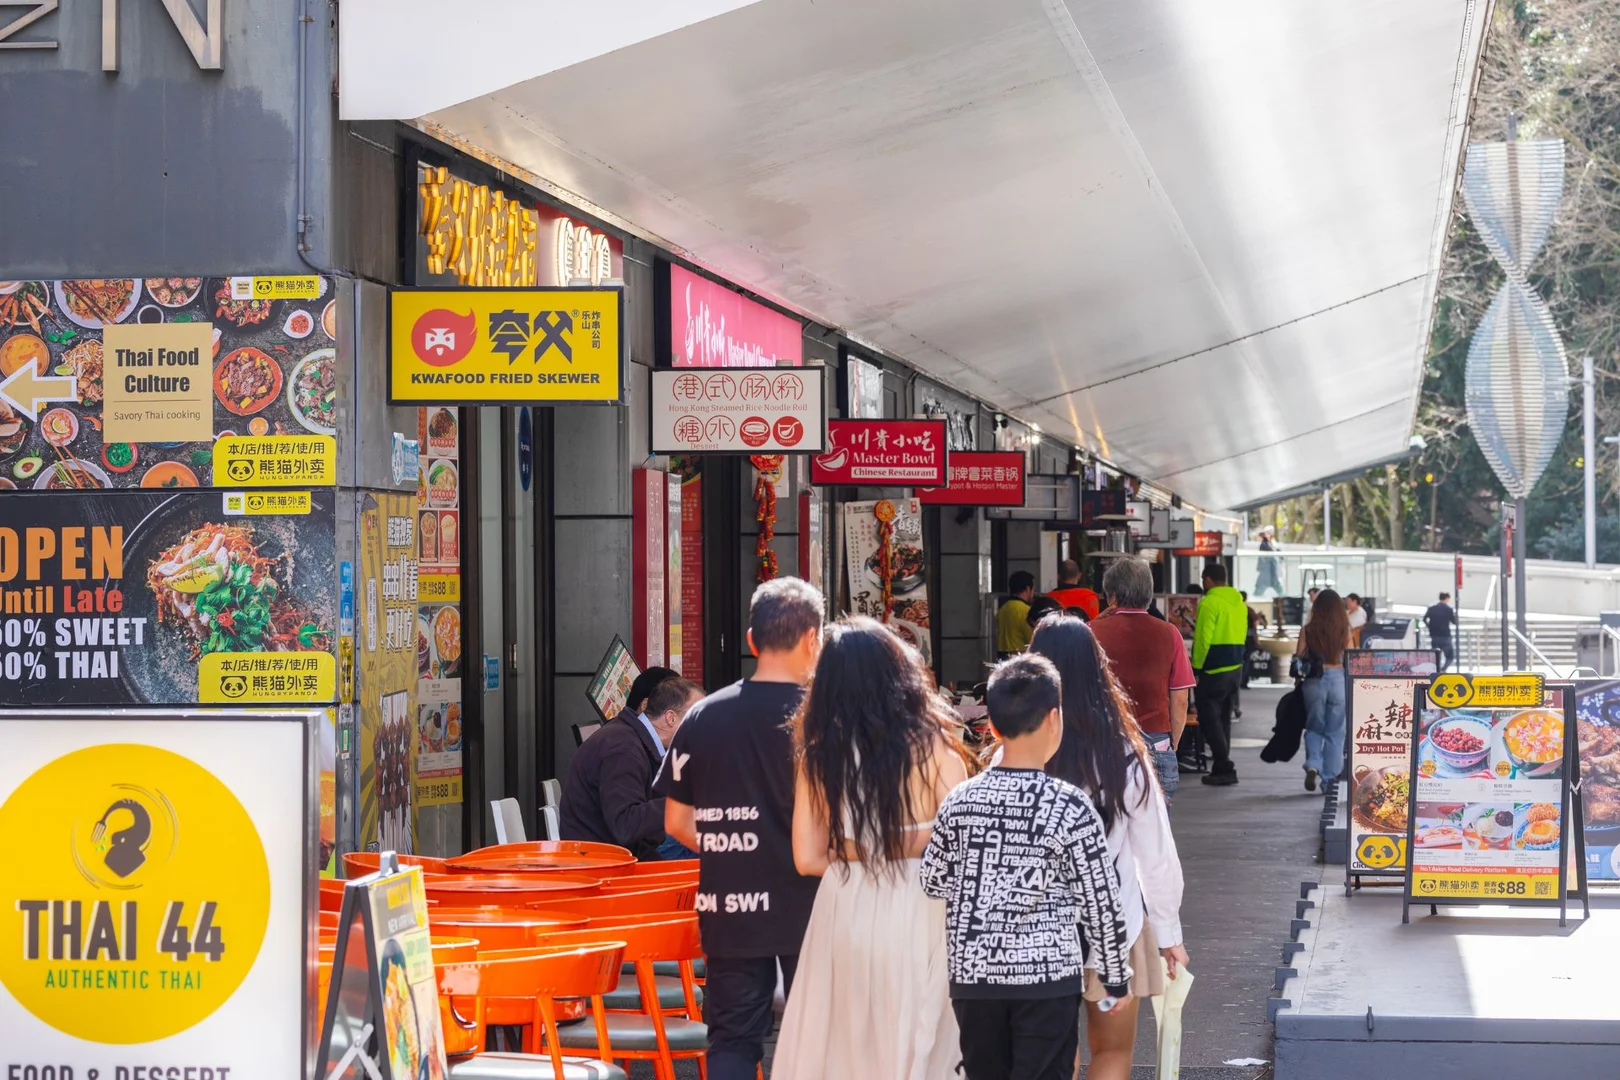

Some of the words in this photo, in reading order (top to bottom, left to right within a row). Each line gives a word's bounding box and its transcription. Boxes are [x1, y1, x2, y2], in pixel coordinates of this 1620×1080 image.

[275, 280, 315, 290] 熊猫外卖
[582, 311, 590, 329] 乐山
[592, 311, 600, 349] 炸串公司
[115, 348, 153, 367] Thai
[158, 347, 199, 366] Food
[124, 374, 190, 393] Culture
[411, 373, 485, 384] KWAFOOD
[490, 373, 533, 384] FRIED
[538, 373, 600, 384] SKEWER
[673, 373, 804, 401] 港式肠粉
[114, 410, 142, 421] Savory
[145, 410, 164, 420] Thai
[167, 410, 201, 421] cooking
[669, 404, 689, 412] Hong
[690, 404, 709, 412] Kong
[674, 415, 736, 443] 糖水
[259, 458, 325, 475] 熊猫外卖
[853, 452, 899, 464] Master
[902, 452, 935, 464] Bowl
[853, 468, 887, 476] Chinese
[888, 468, 935, 477] Restaurant
[266, 495, 307, 506] 熊猫外卖
[64, 586, 123, 614] Late
[55, 618, 147, 647] SWEET
[55, 651, 118, 679] THAI
[252, 675, 318, 691] 熊猫外卖
[1478, 685, 1532, 698] 熊猫外卖
[1362, 744, 1375, 753] Dry
[1377, 744, 1390, 752] Hot
[1391, 744, 1404, 752] Pot
[725, 806, 759, 821] 1856
[1005, 806, 1023, 816] RUE
[1024, 808, 1034, 817] 21
[1002, 818, 1029, 831] KARL
[703, 832, 759, 852] ROAD
[971, 827, 985, 843] 21
[1004, 832, 1031, 844] KARL
[1084, 836, 1098, 854] 21
[964, 849, 980, 877] RUE
[971, 830, 1003, 931] LAGERFELD
[1090, 858, 1105, 888] RUE
[1439, 880, 1480, 890] 熊猫外卖
[1498, 881, 1526, 895] $88
[725, 892, 769, 913] SW1
[16, 900, 137, 962] THAI
[156, 901, 225, 962] 44
[955, 879, 977, 984] ST-GUILLAUME
[46, 969, 149, 990] AUTHENTIC
[160, 970, 201, 990] THAI
